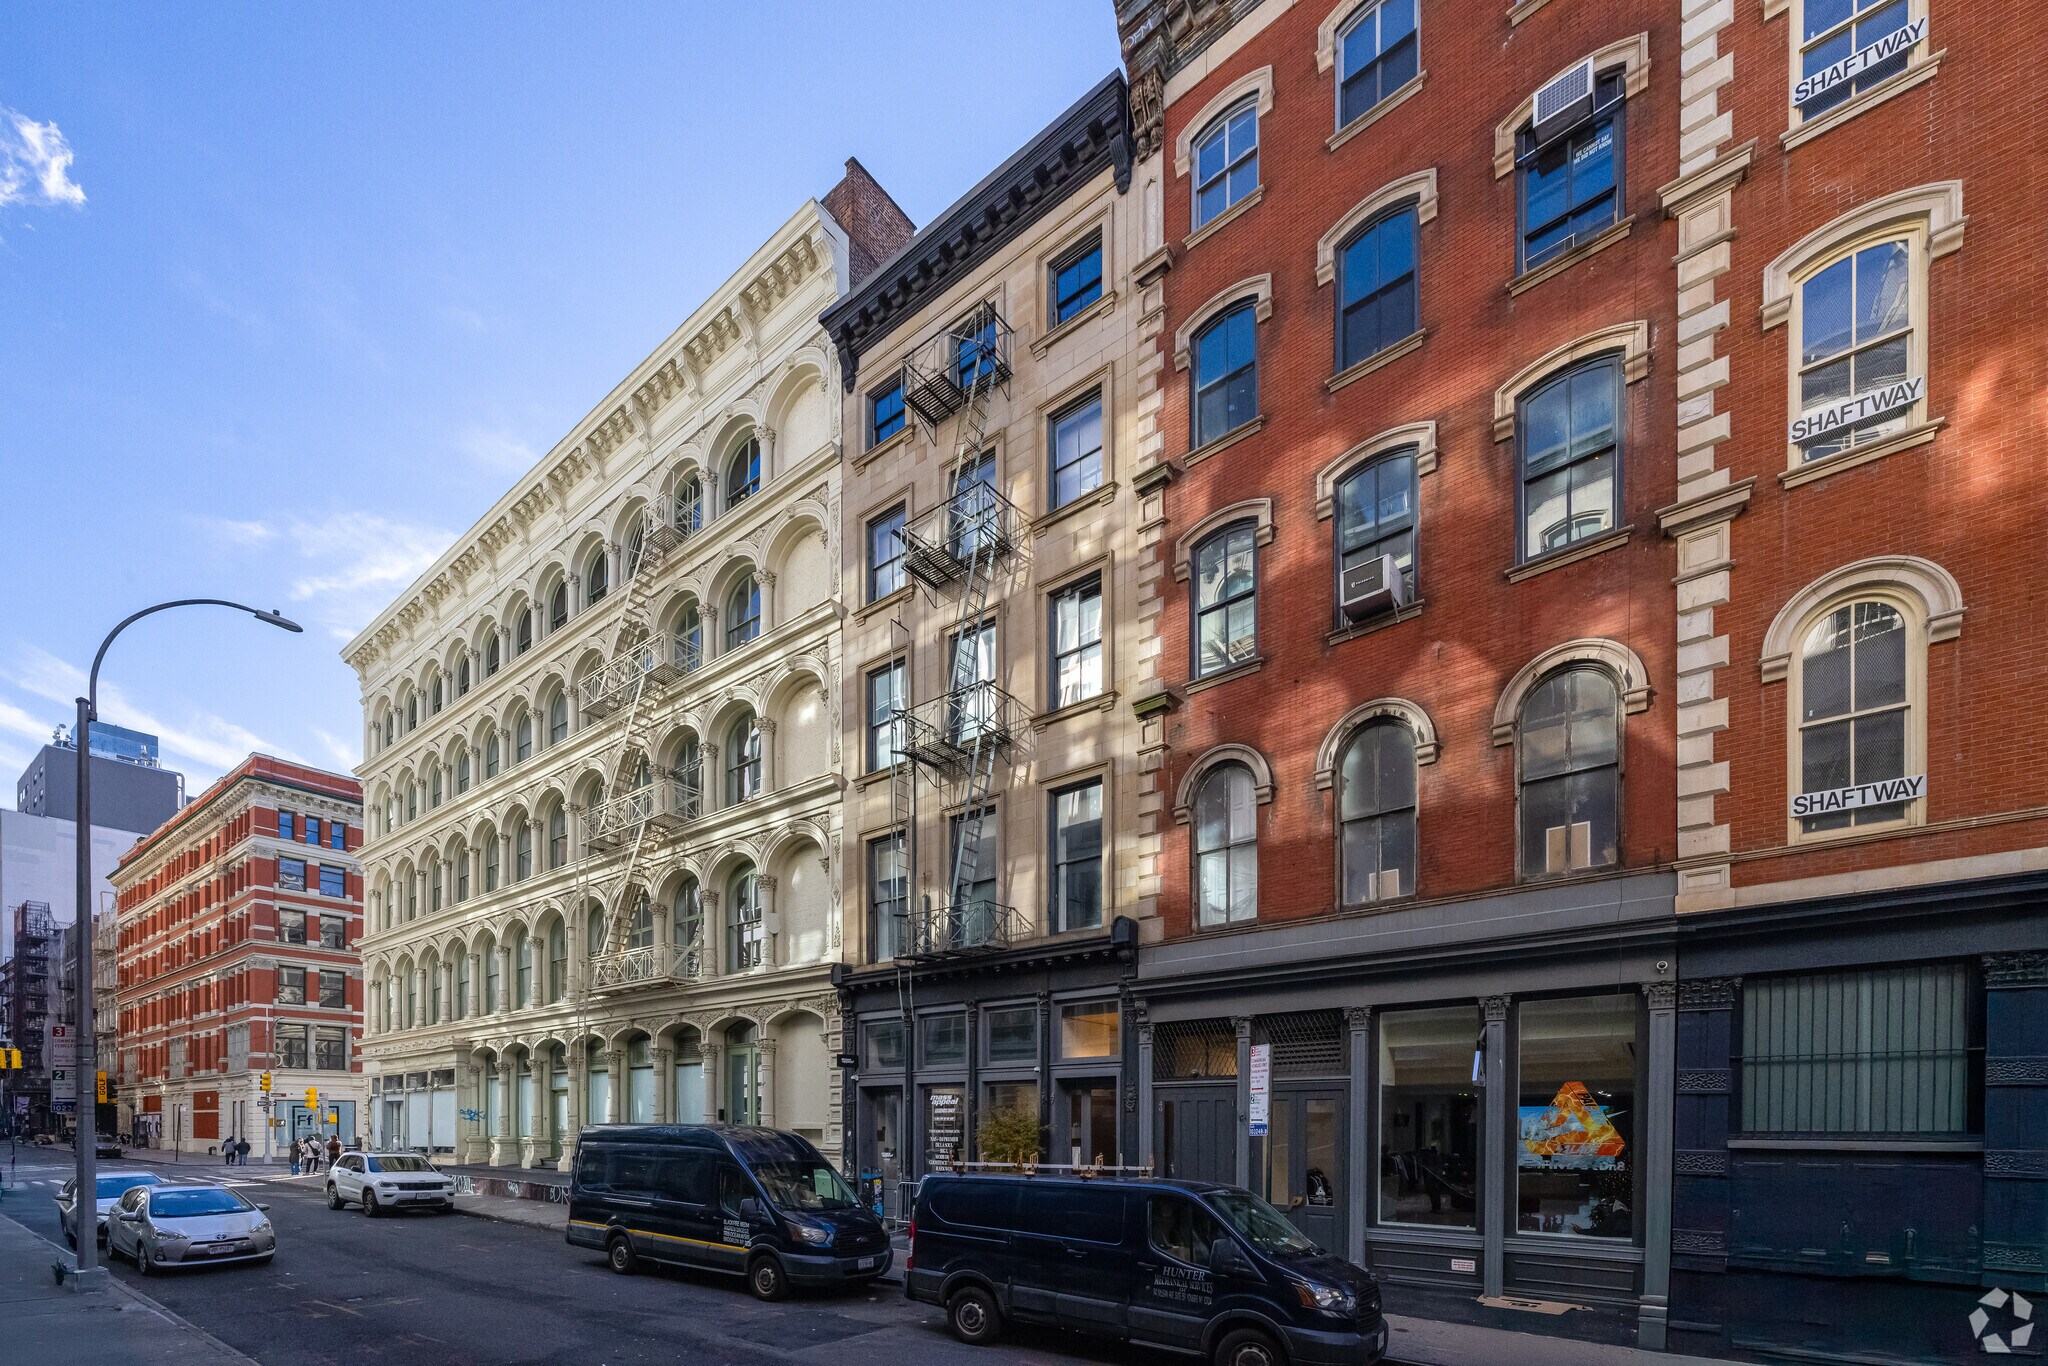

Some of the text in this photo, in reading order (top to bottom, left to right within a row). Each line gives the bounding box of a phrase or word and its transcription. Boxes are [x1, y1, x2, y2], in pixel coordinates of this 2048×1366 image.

[1794, 17, 1926, 103] SHAFTWAY
[1601, 133, 1610, 143] SAY
[1791, 376, 1923, 441] SHAFTWAY
[1793, 776, 1924, 815] SHAFTWAY
[931, 1098, 959, 1106] appeal
[297, 1114, 313, 1126] Ff
[1163, 1266, 1206, 1281] HUNTER
[1154, 1273, 1213, 1294] MECHANICAL SERVICES
